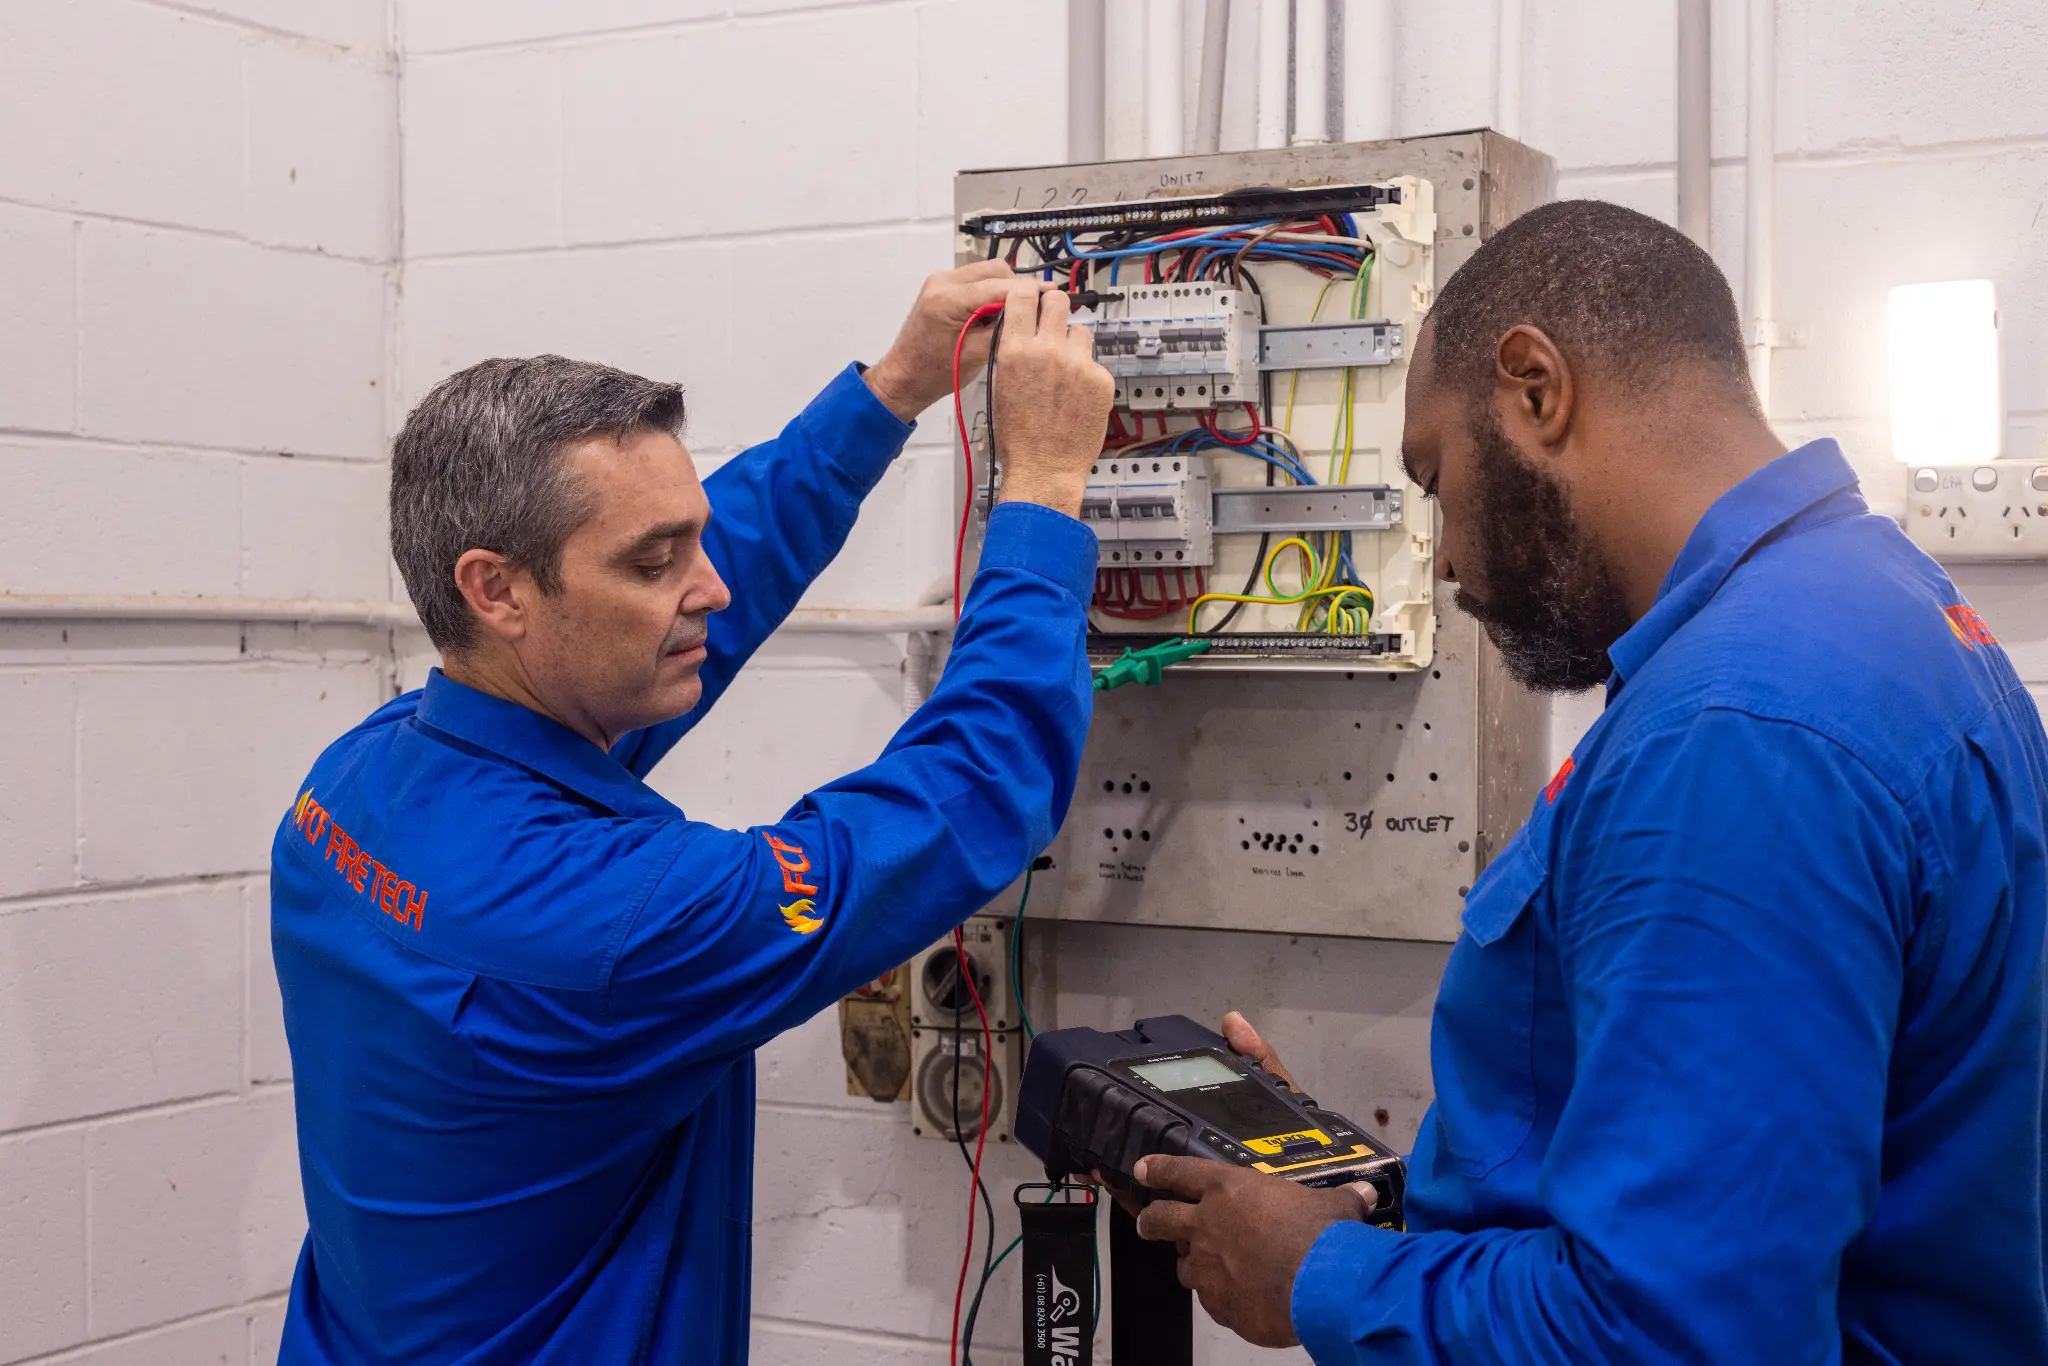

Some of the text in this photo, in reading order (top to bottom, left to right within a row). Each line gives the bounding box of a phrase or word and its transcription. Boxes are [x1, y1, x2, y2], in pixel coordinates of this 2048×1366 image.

[1160, 173, 1192, 187] UNIT
[298, 798, 330, 846] FCF
[1386, 815, 1454, 833] OUTLET
[762, 831, 818, 896] FCF
[1036, 1273, 1047, 1349] (+61) 08 8243 3500
